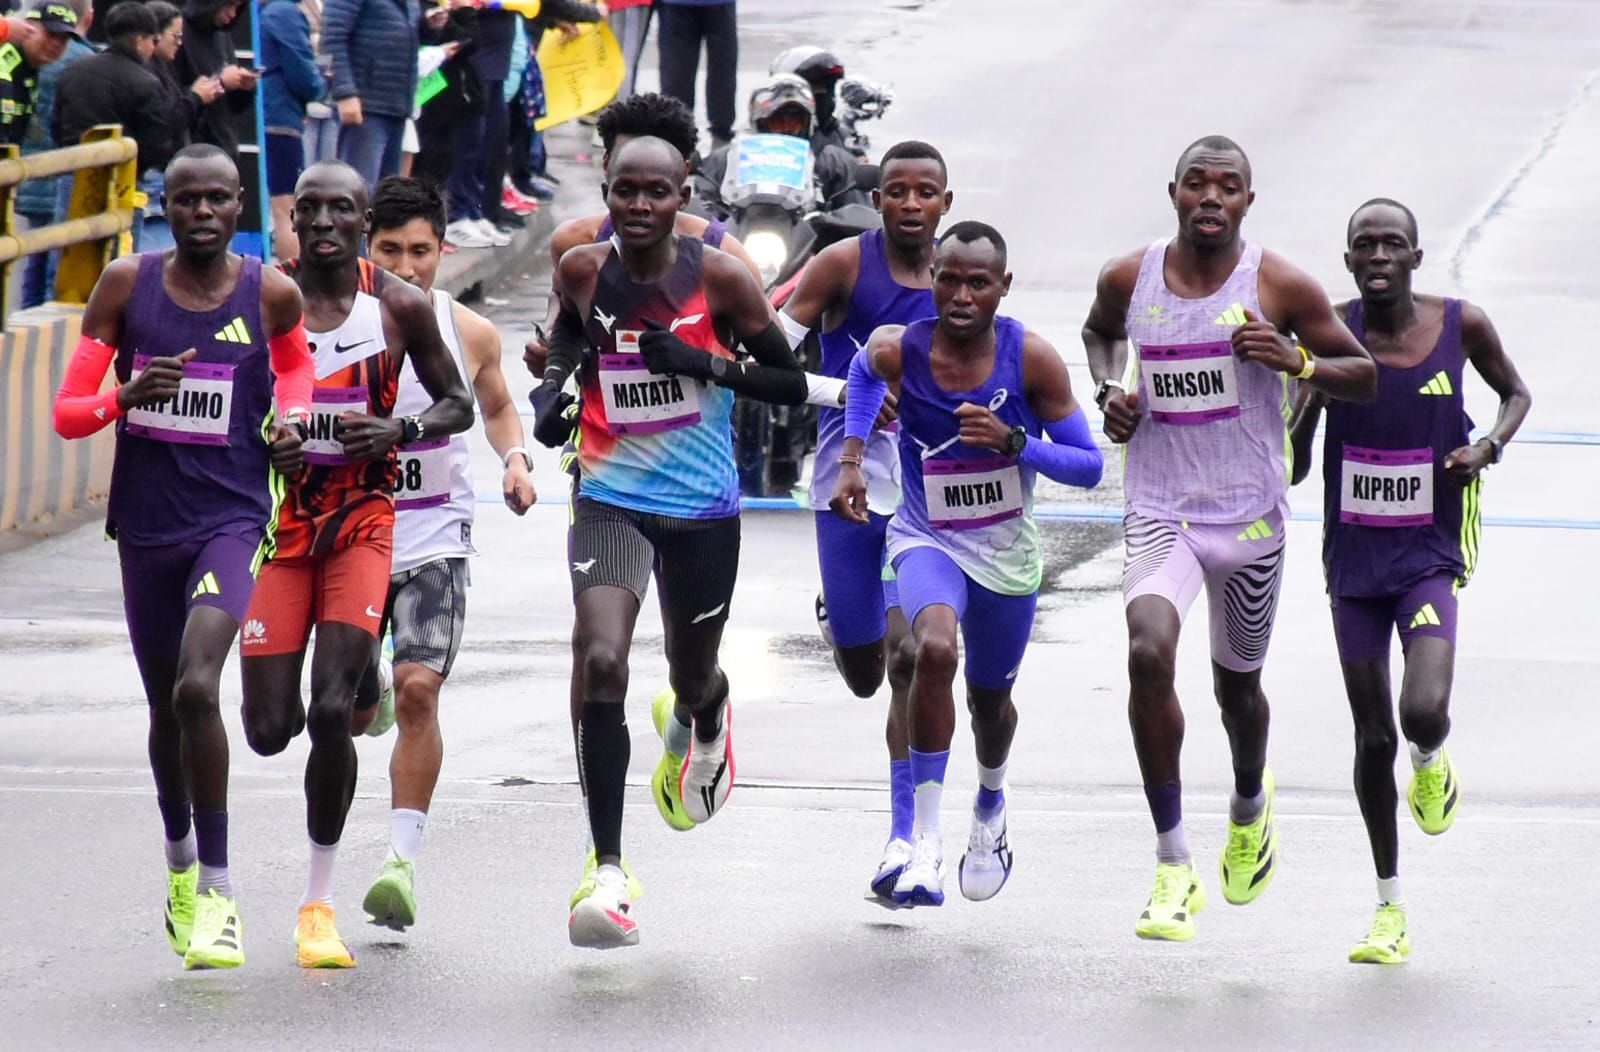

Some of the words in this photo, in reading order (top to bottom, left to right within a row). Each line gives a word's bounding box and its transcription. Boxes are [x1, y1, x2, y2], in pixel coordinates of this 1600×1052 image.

[613, 379, 684, 408] MATATA
[1153, 369, 1225, 398] BENSON
[136, 390, 223, 419] LIMO
[944, 480, 1003, 507] MUTAI
[1353, 474, 1421, 502] KIPROP
